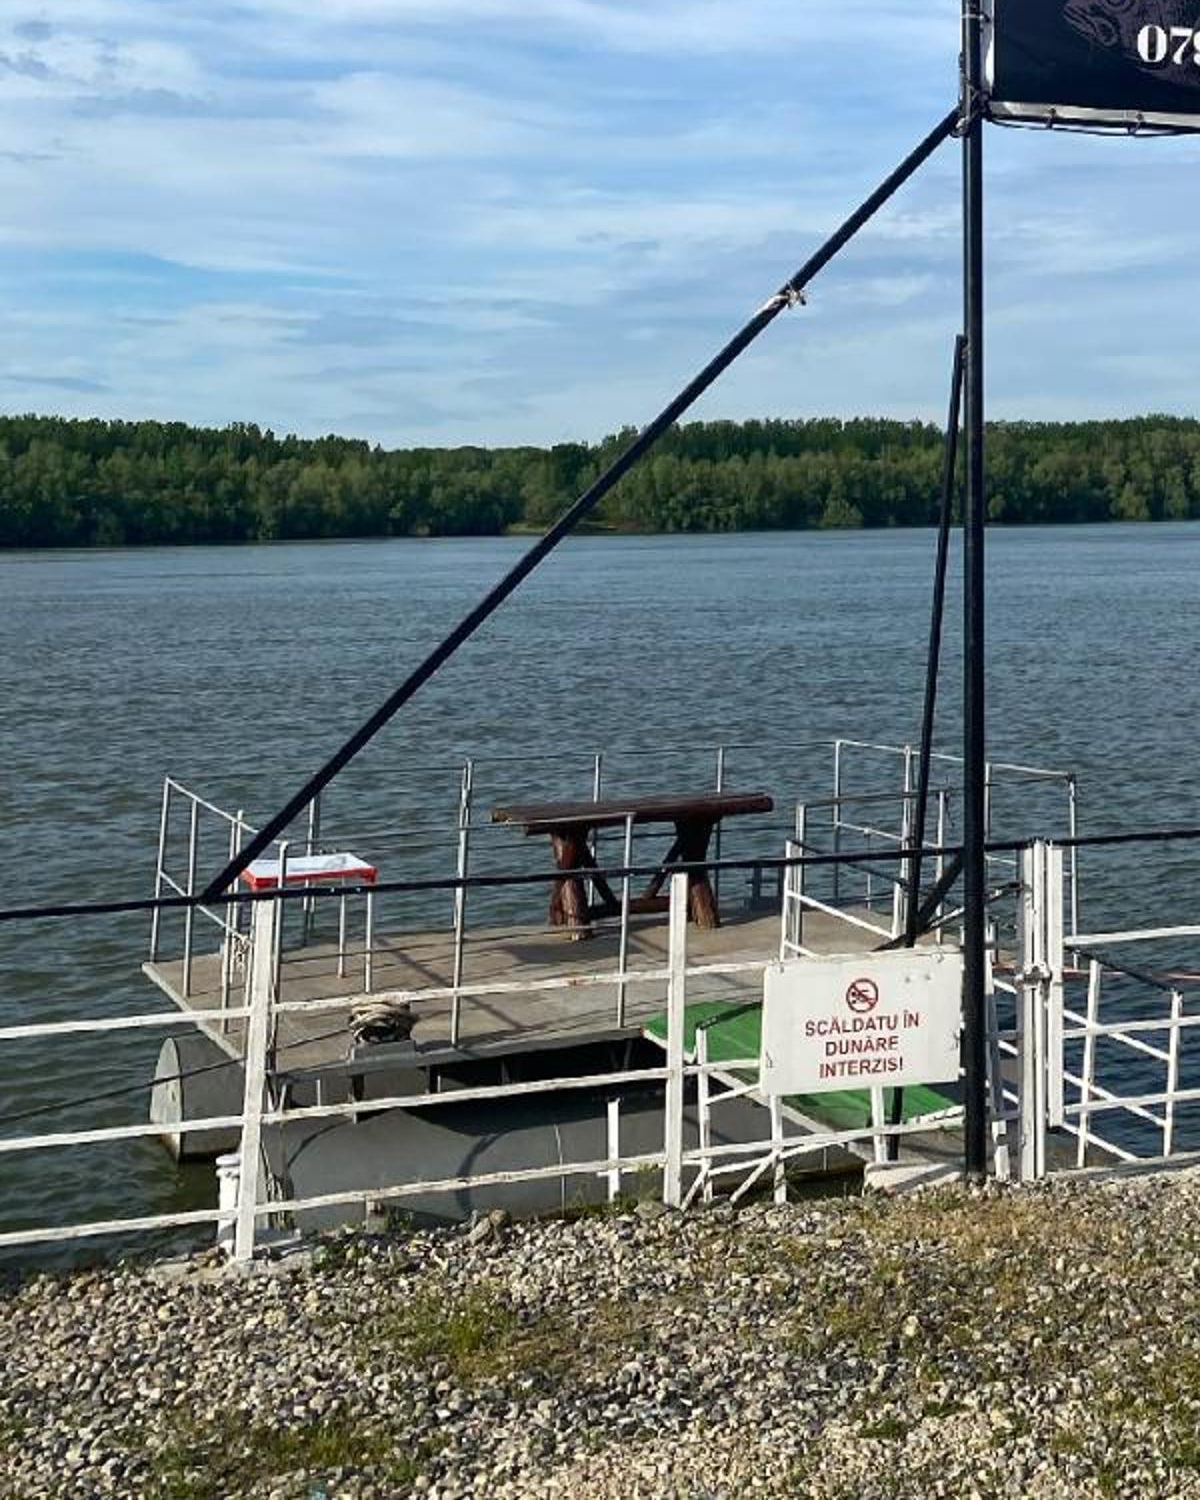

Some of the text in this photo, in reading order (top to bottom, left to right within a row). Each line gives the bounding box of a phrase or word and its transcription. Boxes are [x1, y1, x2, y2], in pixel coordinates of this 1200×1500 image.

[804, 1009, 920, 1037] SCĂLDATU ÎN
[825, 1036, 899, 1056] DUNĂRE
[819, 1056, 904, 1079] INTERZIS!
